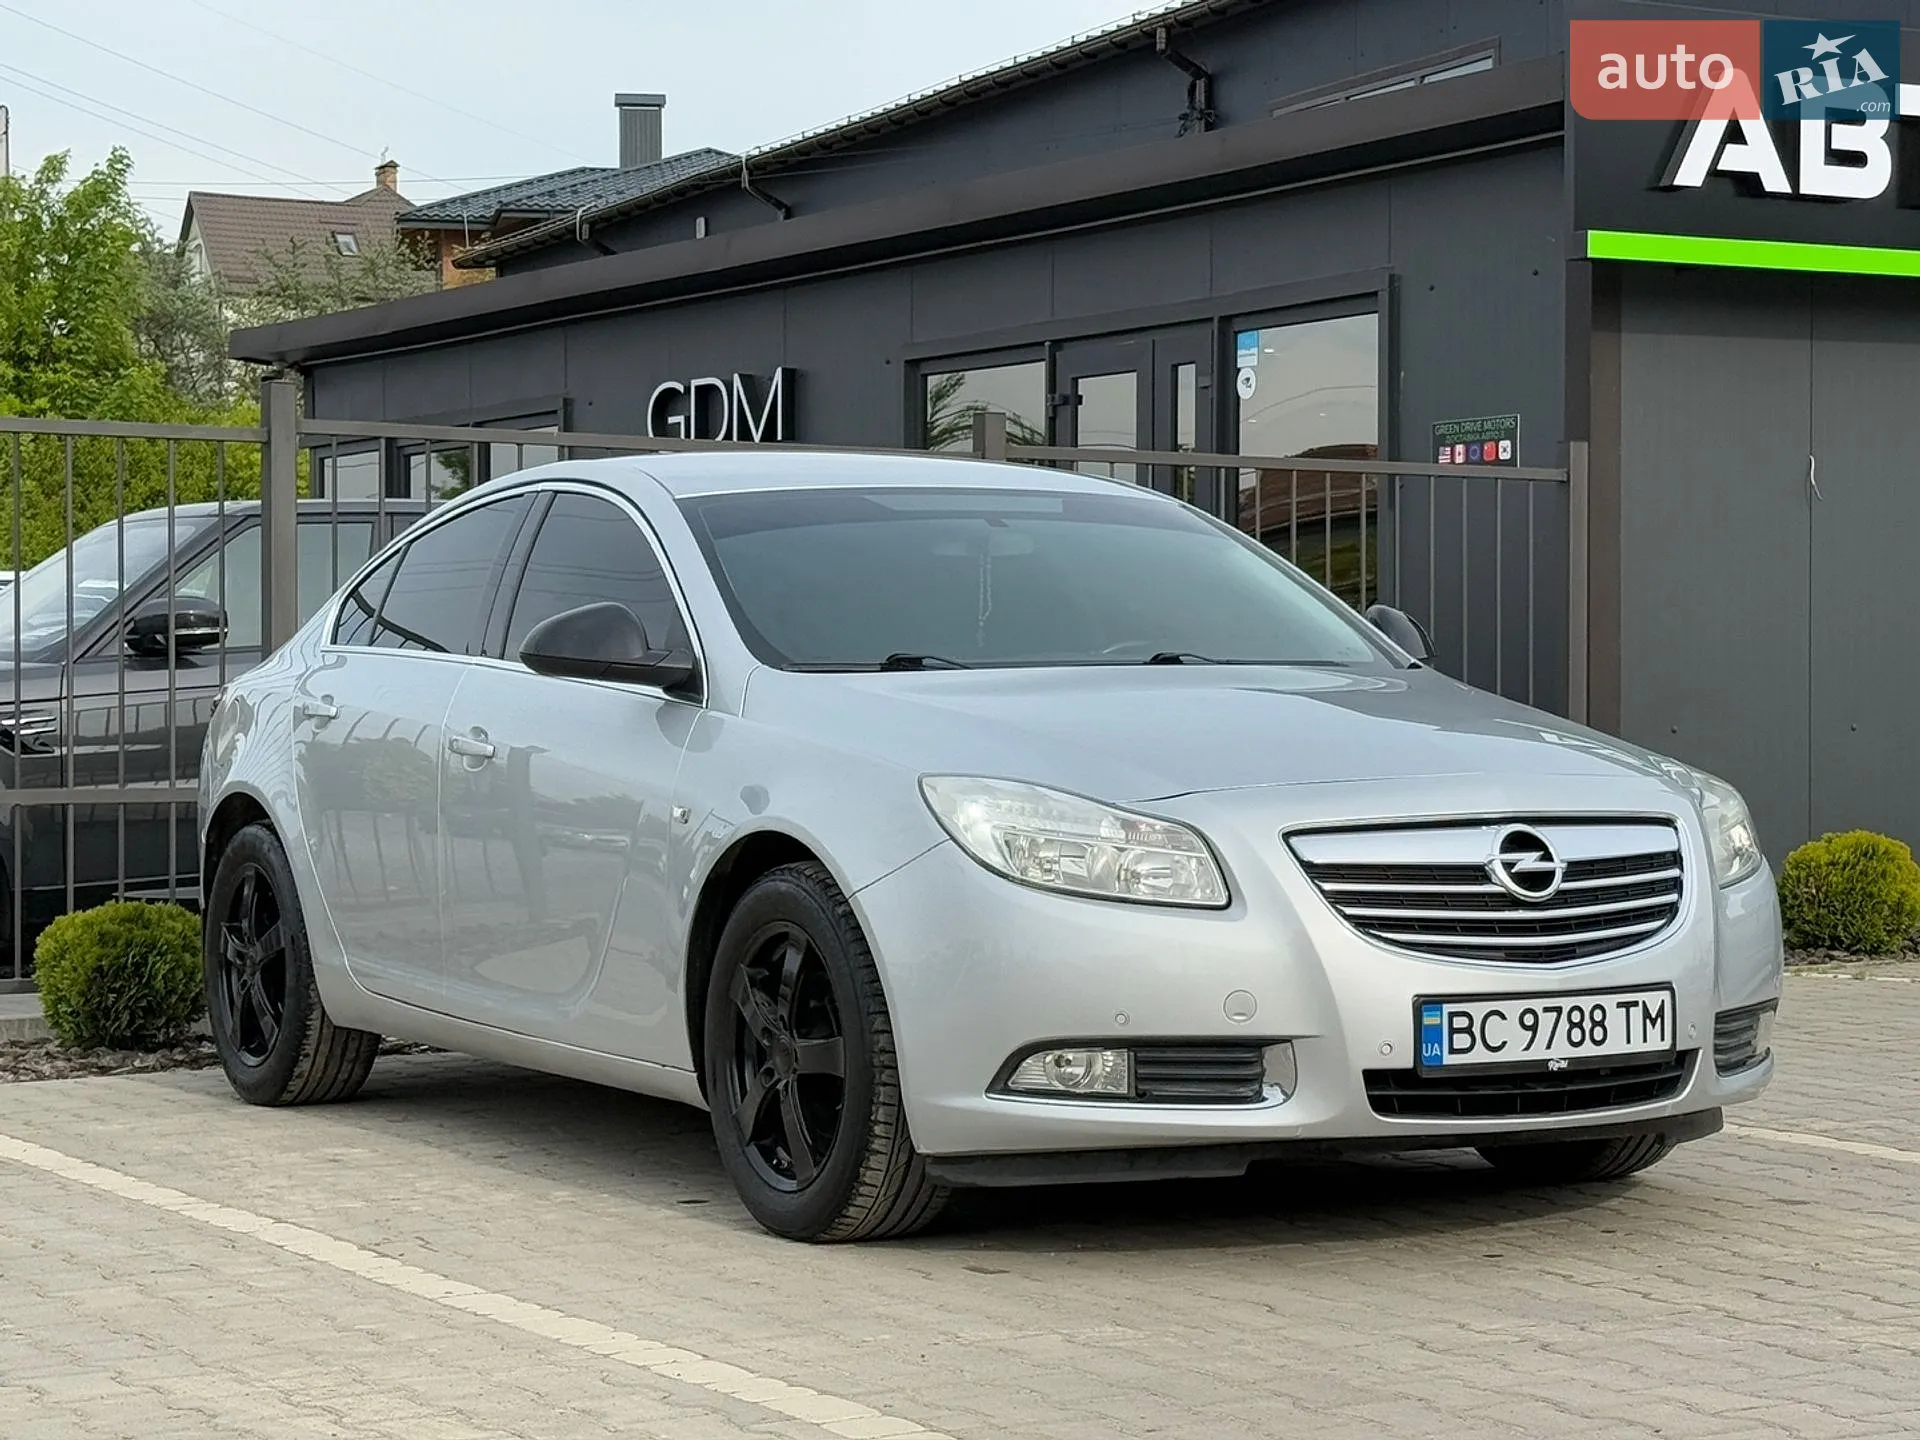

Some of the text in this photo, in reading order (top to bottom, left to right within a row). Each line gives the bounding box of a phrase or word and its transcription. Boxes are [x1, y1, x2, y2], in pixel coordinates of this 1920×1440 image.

[647, 366, 783, 443] GDM
[1434, 418, 1516, 436] GREEN DRIVE MOTORS
[1448, 999, 1666, 1055] BC 9788 TM
[1422, 1042, 1441, 1058] UA
